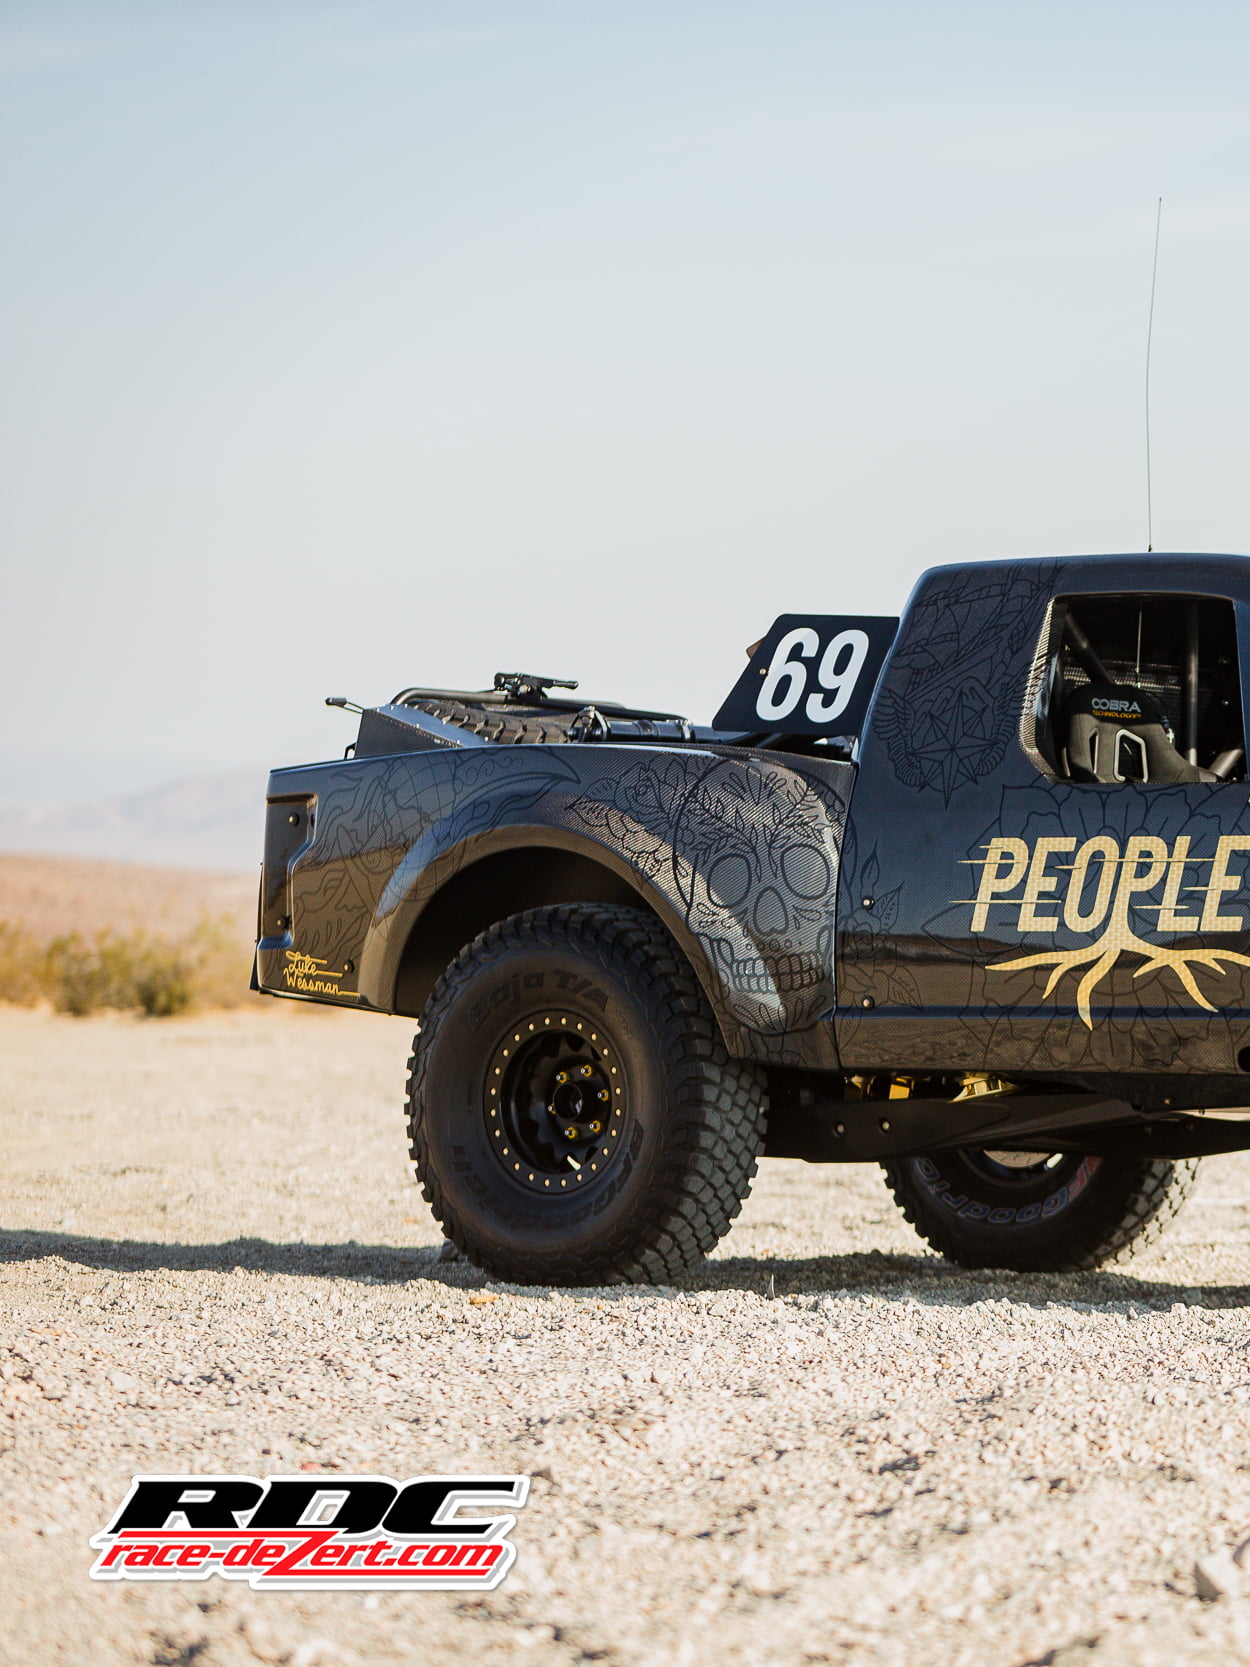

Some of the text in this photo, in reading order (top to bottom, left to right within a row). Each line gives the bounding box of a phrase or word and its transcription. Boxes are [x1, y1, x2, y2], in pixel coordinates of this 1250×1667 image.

[756, 627, 870, 724] 69
[1091, 698, 1141, 713] COBRA
[1092, 710, 1137, 719] TECHNOLOGY
[285, 950, 343, 977] Luke
[283, 968, 361, 998] Wessman
[464, 970, 546, 1033] Baja
